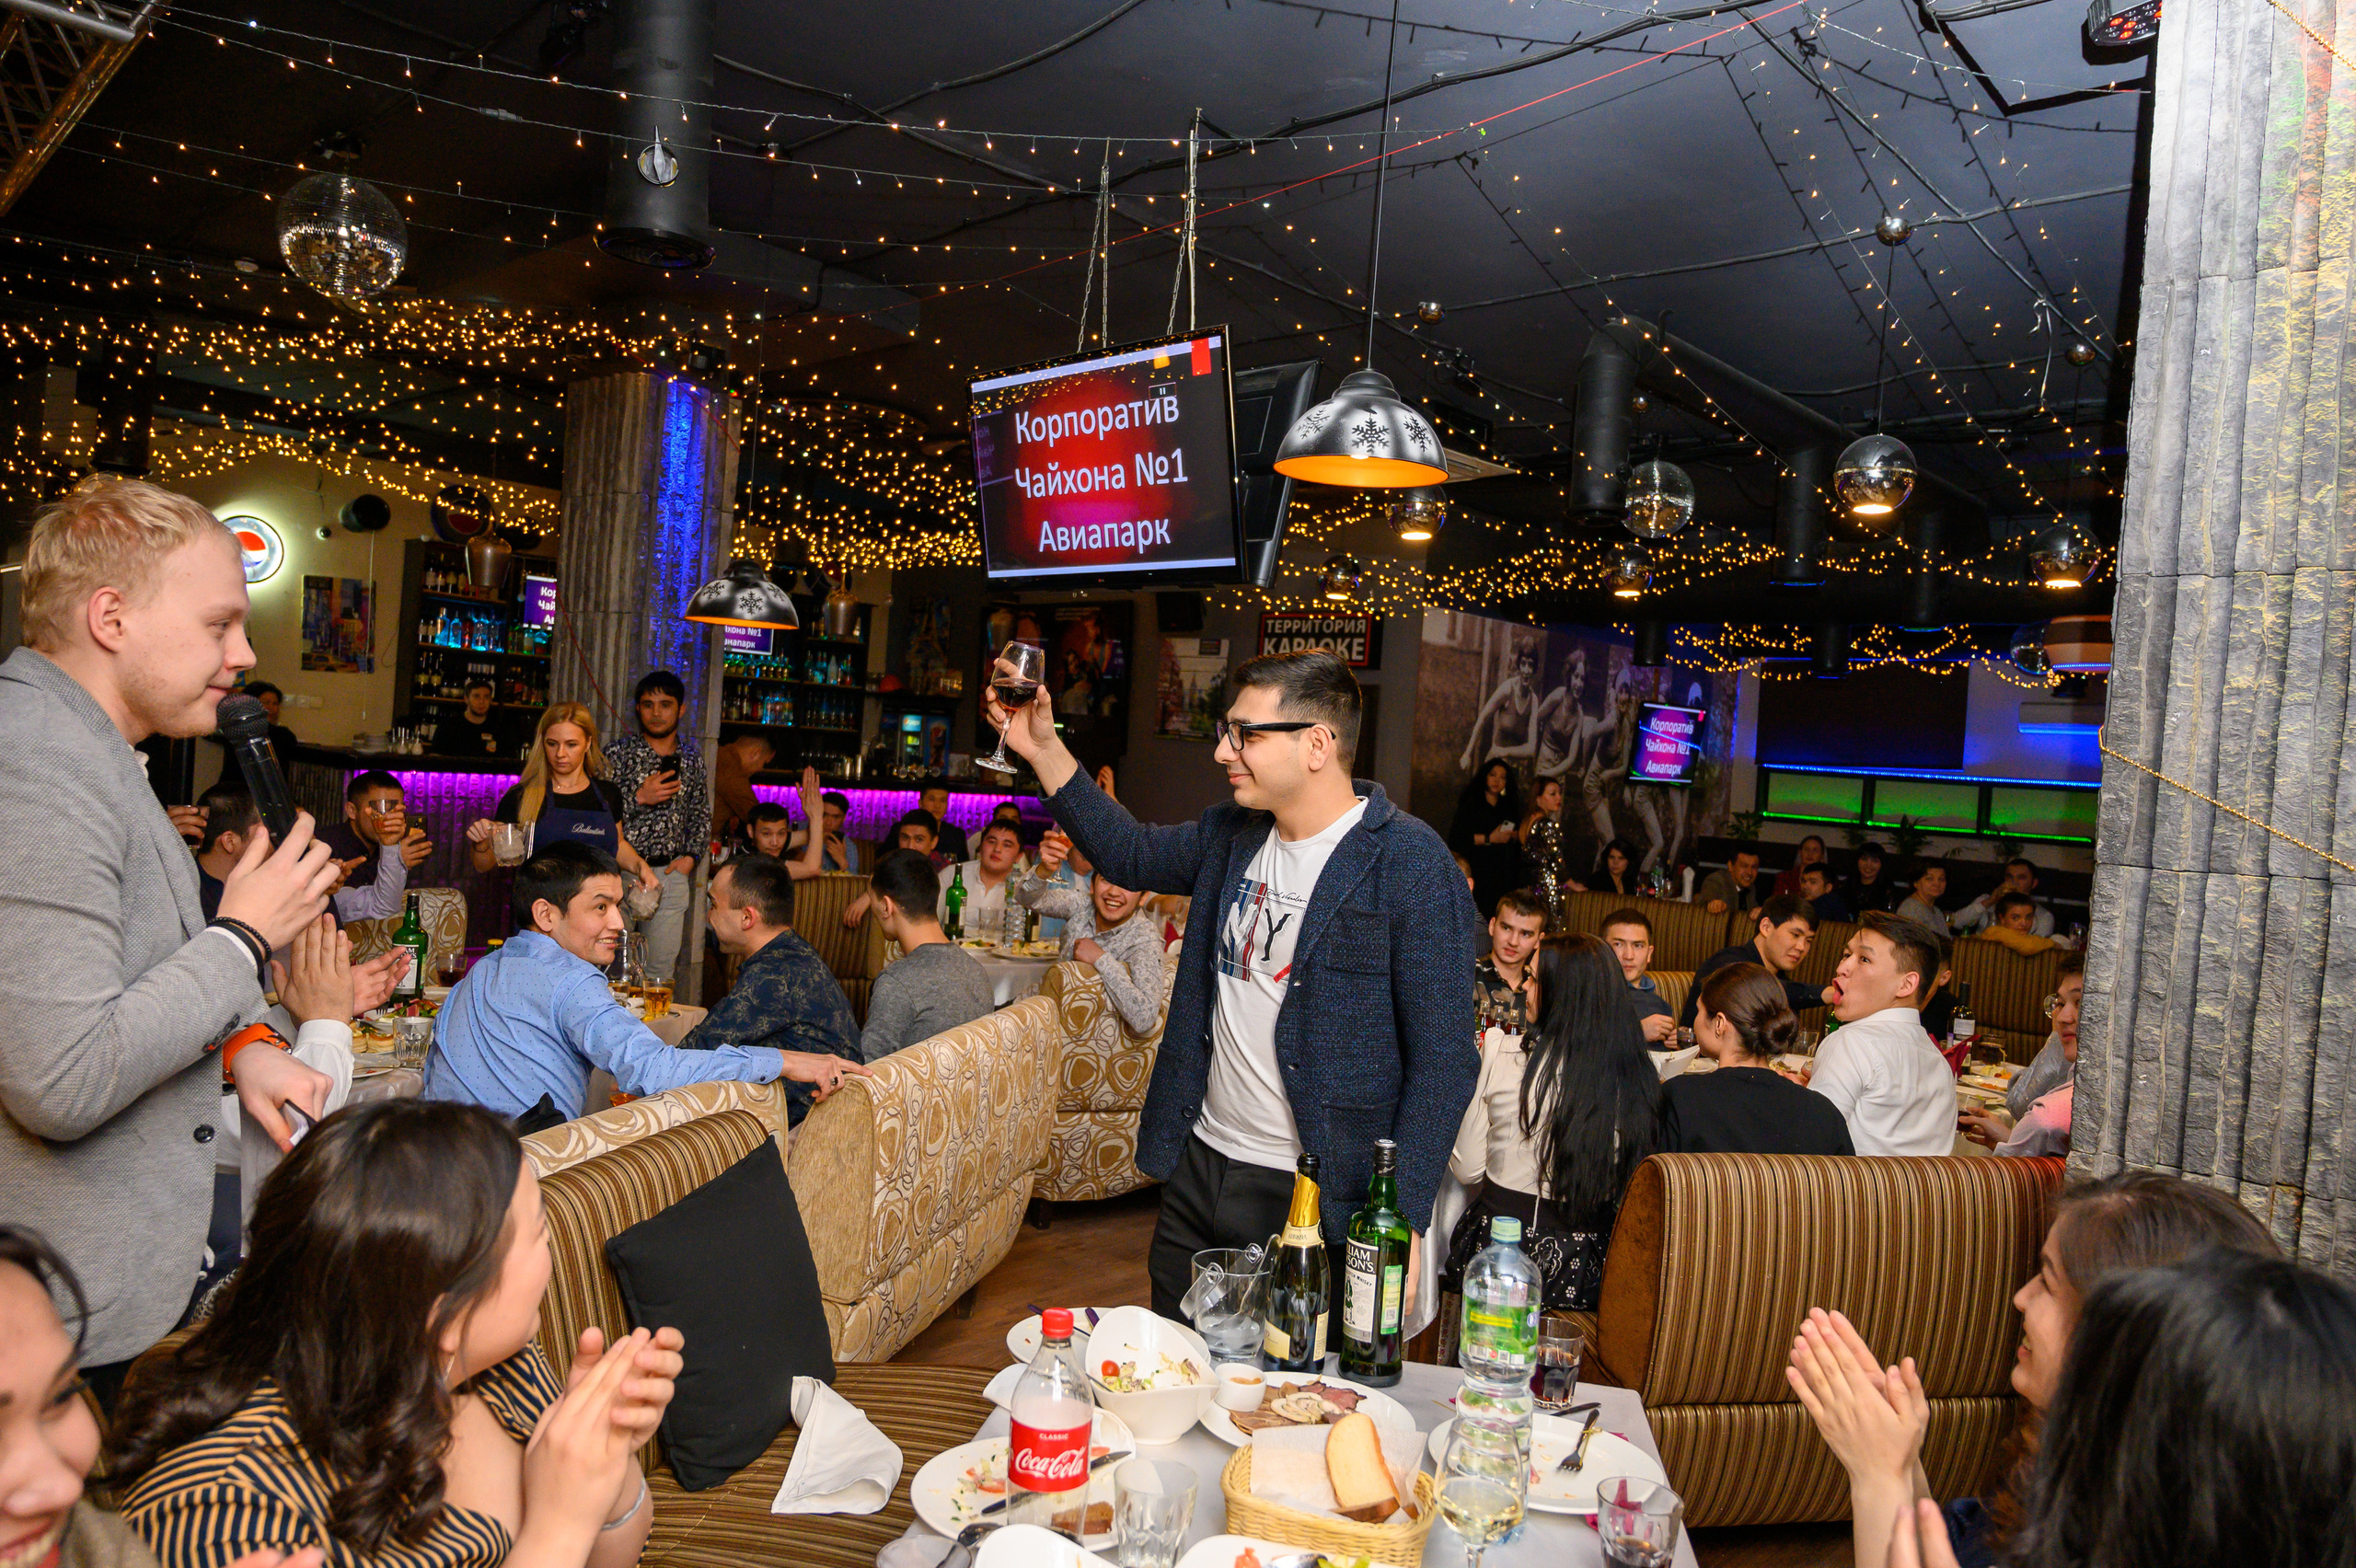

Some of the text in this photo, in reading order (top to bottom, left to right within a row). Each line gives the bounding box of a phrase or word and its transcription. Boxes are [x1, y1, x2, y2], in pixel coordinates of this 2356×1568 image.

[1015, 396, 1180, 447] Корпоратив
[1015, 448, 1188, 498] Чайхона №1
[1039, 518, 1171, 554] Авиапарк
[1266, 619, 1366, 633] ТЕРРИТОРИЯ
[1650, 717, 1694, 735] Корпоратив
[1646, 738, 1676, 754] Чайхона
[1646, 760, 1681, 778] Авиапарк
[1039, 1433, 1068, 1441] CLASSIC
[1015, 1446, 1085, 1479] Coca-Cola
